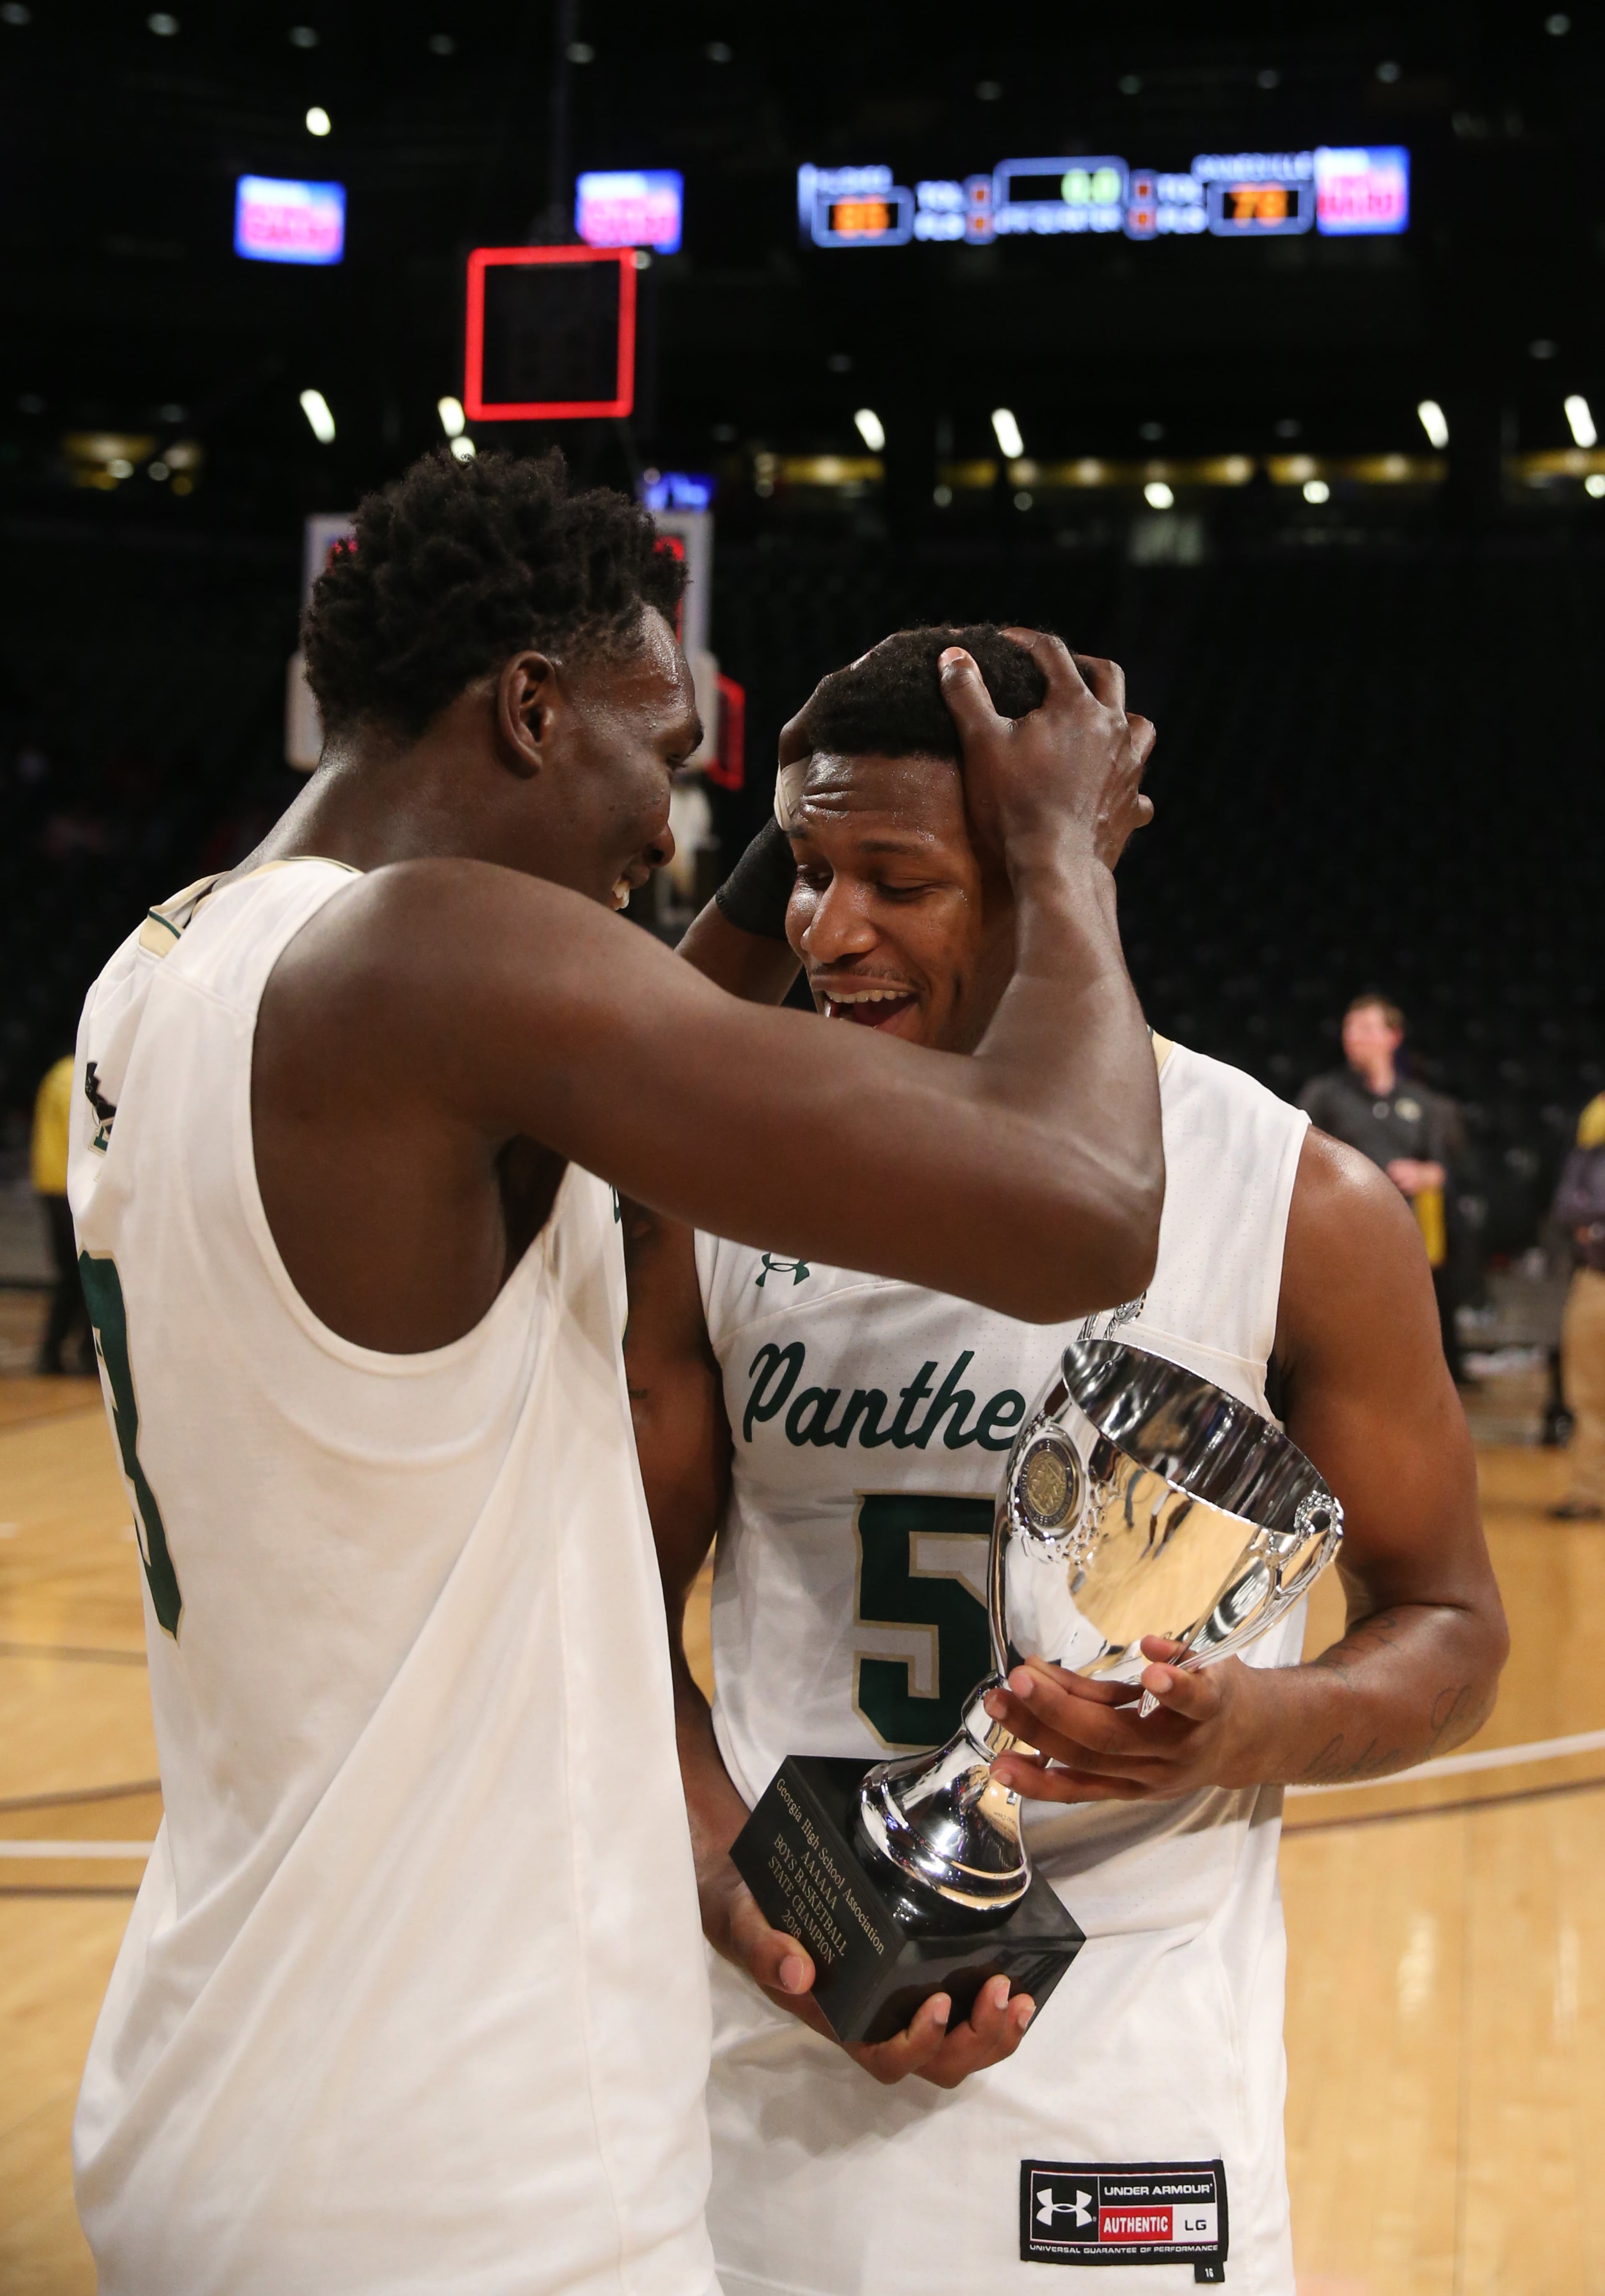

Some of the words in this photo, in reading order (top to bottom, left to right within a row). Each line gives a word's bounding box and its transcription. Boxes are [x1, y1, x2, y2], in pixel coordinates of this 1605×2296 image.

[743, 1341, 1027, 1451] Panthe
[853, 1489, 997, 1750] 5
[774, 1833, 797, 1871] BOYS
[795, 1867, 847, 1956] BASKETBALL
[777, 1779, 802, 1822] Georgia
[801, 1818, 819, 1850] High
[819, 1847, 845, 1889] School
[843, 1888, 884, 1955] Association
[801, 1851, 837, 1910] AAAAAA
[768, 1856, 794, 1897] STATE
[792, 1895, 836, 1964] CHAMPION
[782, 1909, 802, 1938] 2018
[1104, 2186, 1149, 2196] UNDER
[1152, 2185, 1210, 2195] ARMOUR
[1030, 2245, 1080, 2253] UNIVERSAL
[1103, 2217, 1168, 2233] AUTHENTIC
[1185, 2220, 1206, 2231] LG
[1205, 2268, 1214, 2278] 16
